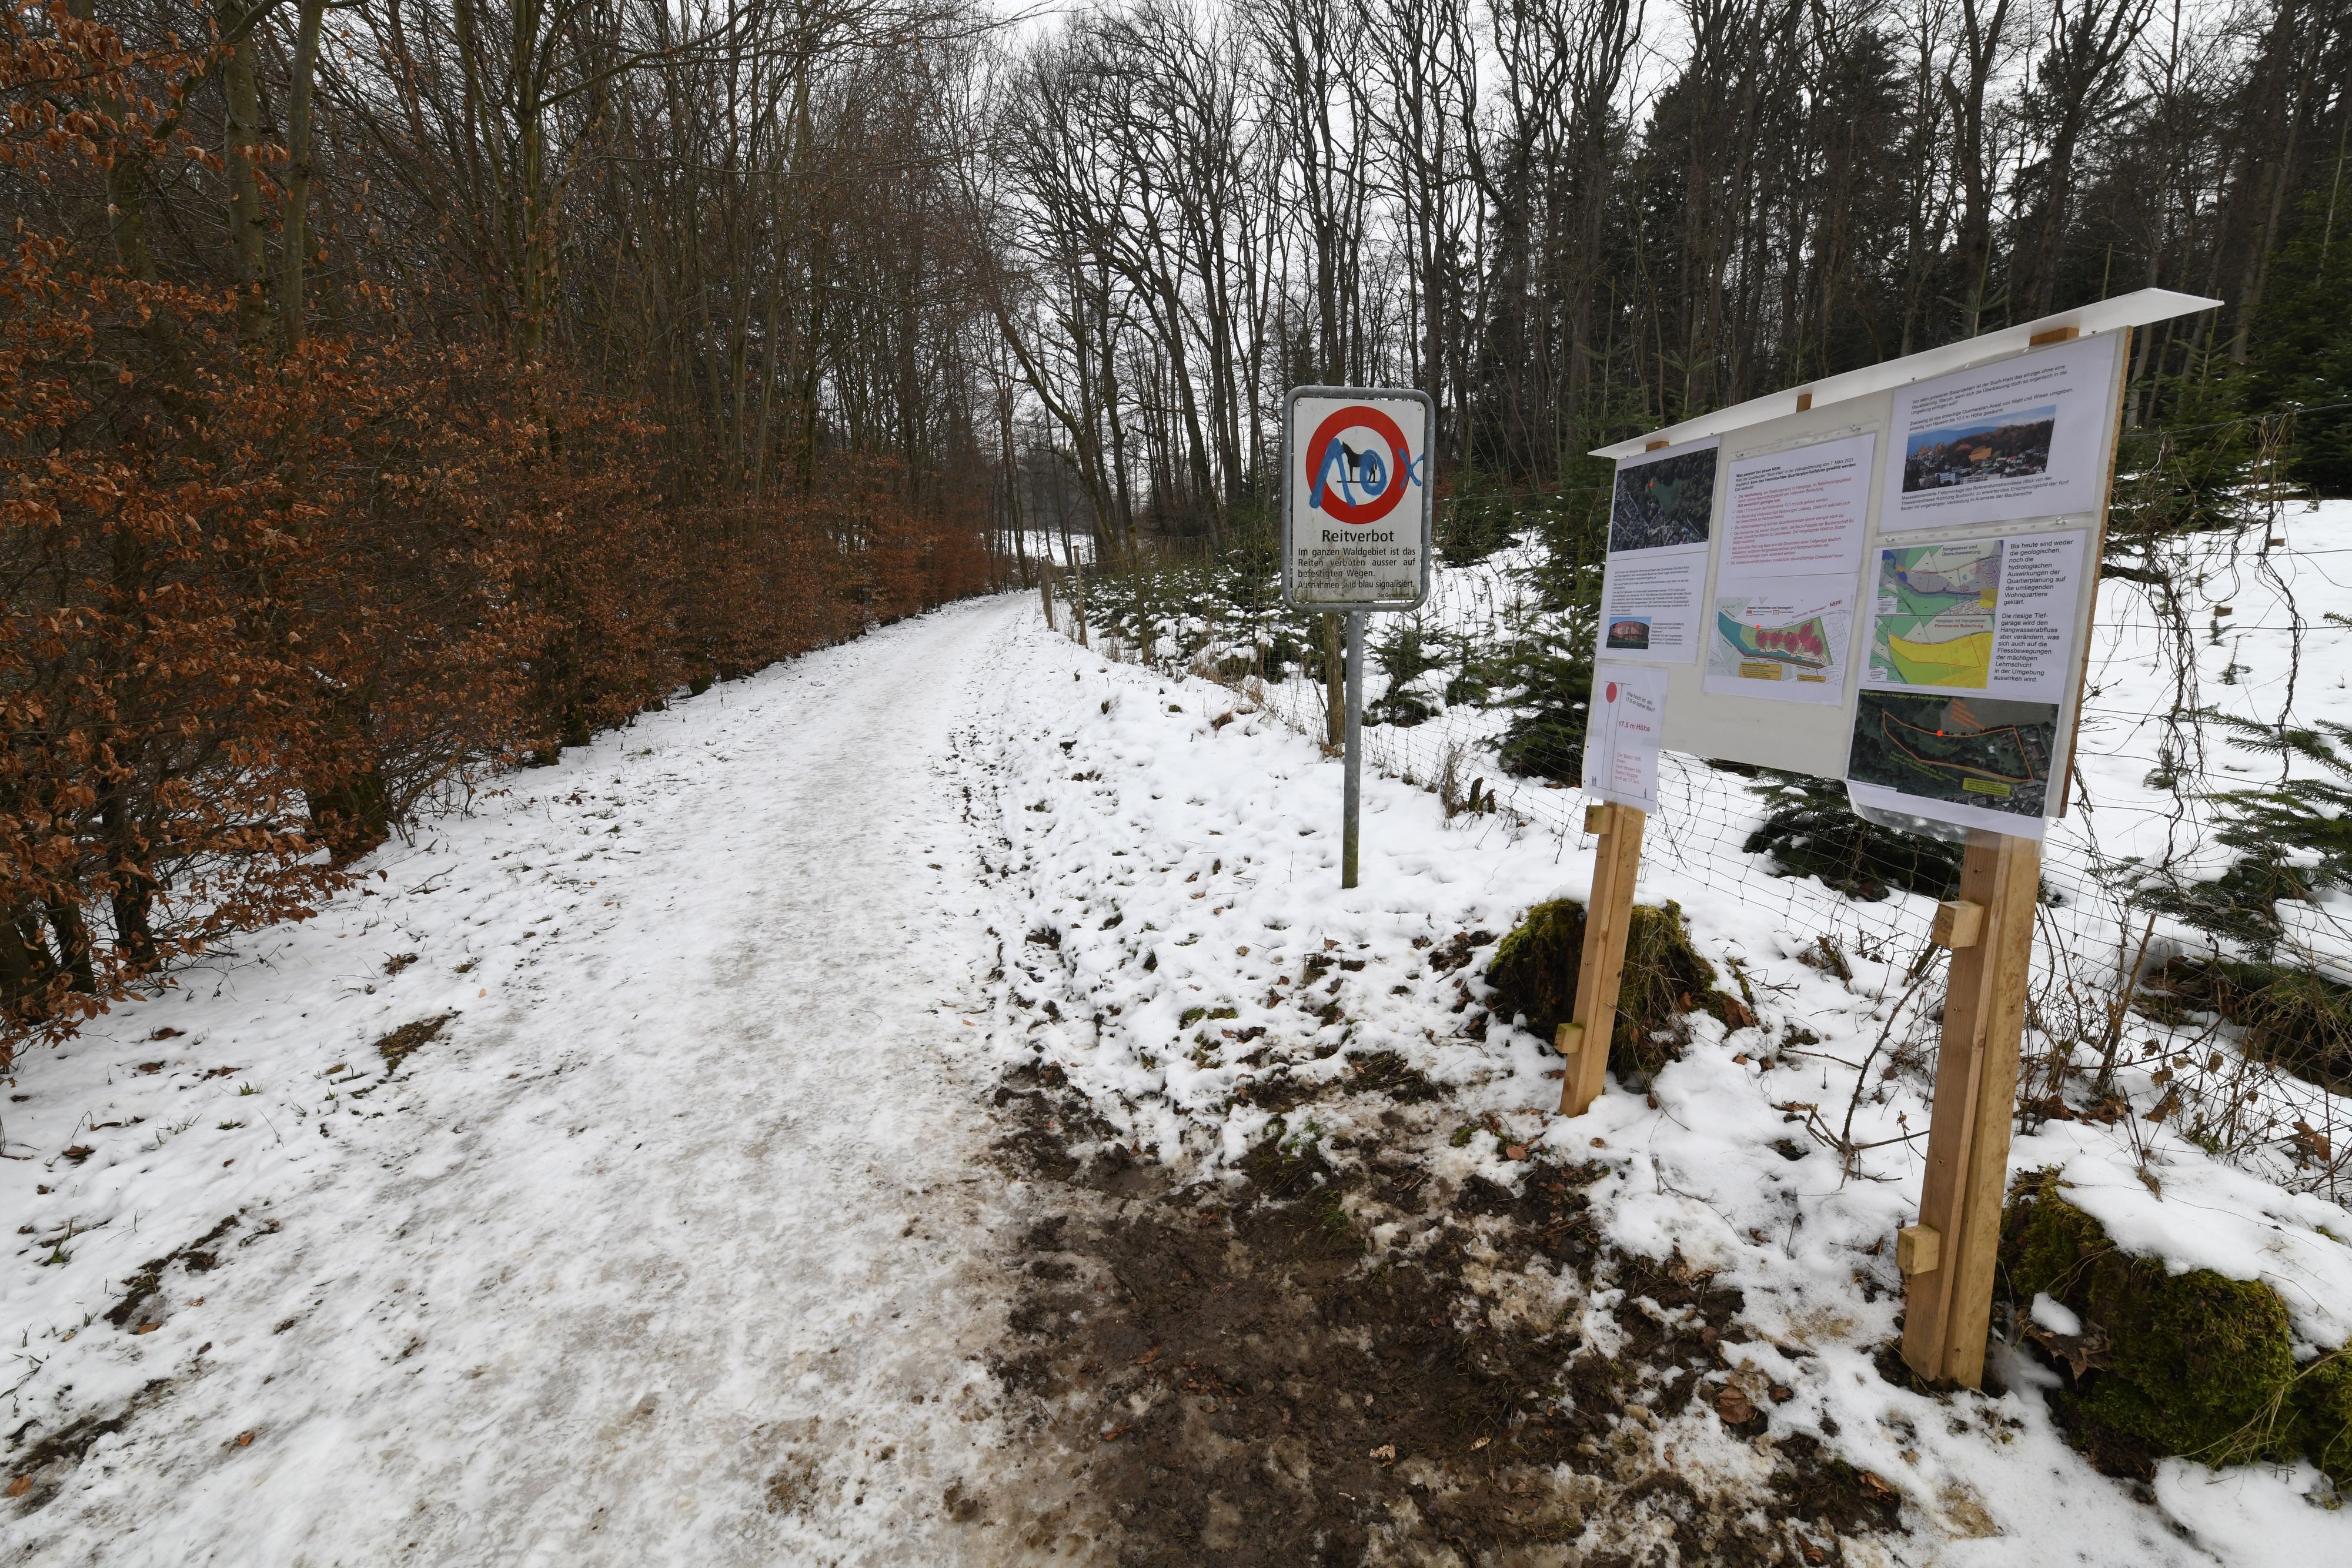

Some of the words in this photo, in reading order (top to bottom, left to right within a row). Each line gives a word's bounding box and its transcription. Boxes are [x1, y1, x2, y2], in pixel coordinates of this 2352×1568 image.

[1322, 530, 1394, 542] Reitverbot
[1312, 549, 1339, 557] ganzen
[1343, 547, 1386, 557] Waldgebiet
[2020, 547, 2060, 556] geologischen,
[2008, 562, 2052, 570] hydrologischen
[1298, 569, 1342, 579] befestigten
[1347, 569, 1375, 578] Wegen.
[1376, 580, 1414, 589] signalisiert.
[2012, 668, 2044, 676] Umgebung
[1636, 724, 1650, 732] Höhe
